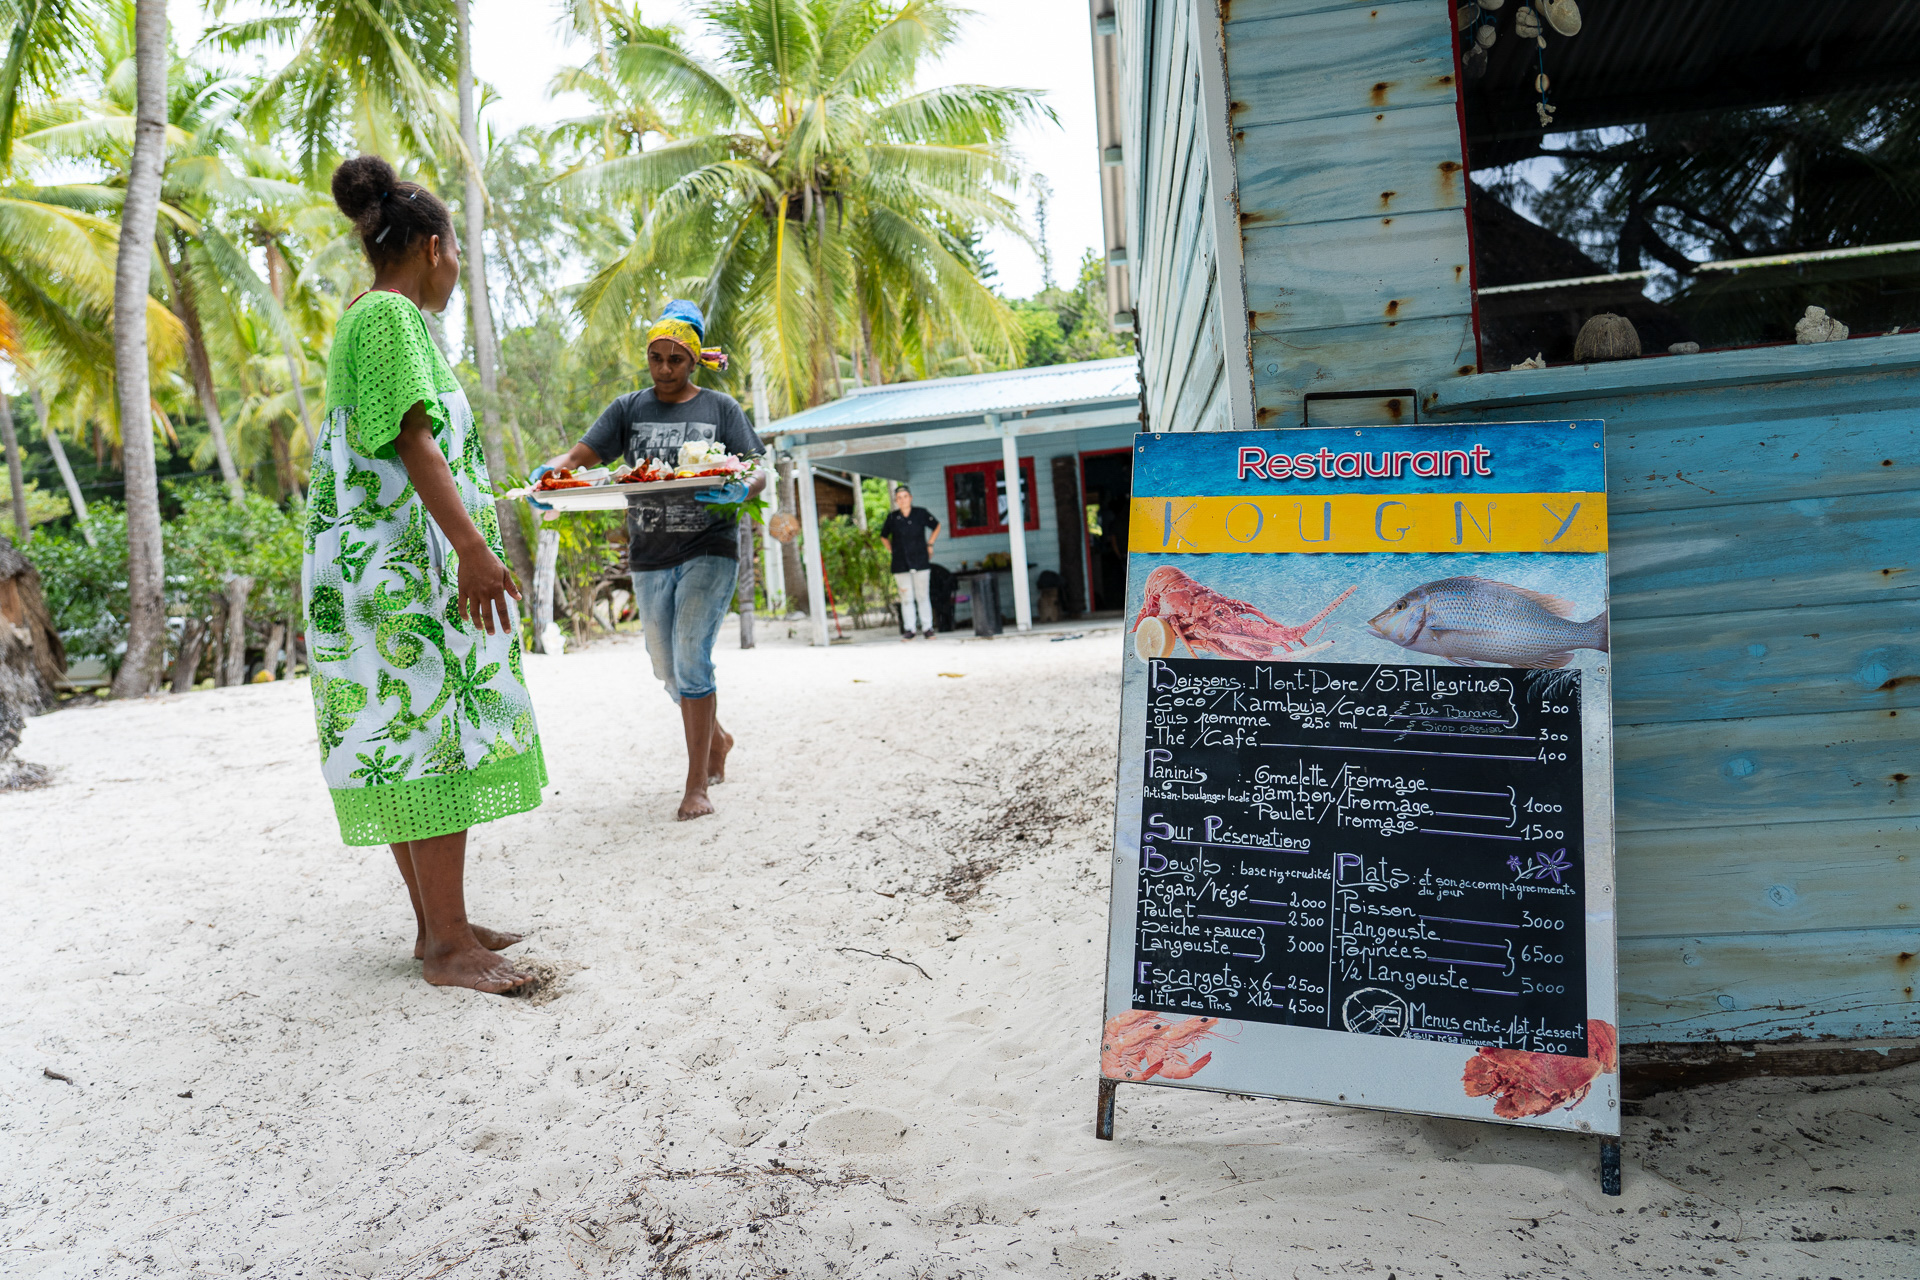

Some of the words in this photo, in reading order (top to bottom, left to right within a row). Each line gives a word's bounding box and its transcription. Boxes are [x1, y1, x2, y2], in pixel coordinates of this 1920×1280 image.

[1238, 444, 1491, 479] Restaurant
[1162, 501, 1581, 548] KOUGNY
[1541, 701, 1569, 714] 500
[1194, 712, 1271, 732] pomme
[1301, 717, 1331, 730] 250
[1340, 715, 1357, 729] ml
[1539, 728, 1568, 741] 300
[1538, 747, 1567, 764] 400
[1145, 749, 1208, 791] Paninis
[1523, 797, 1562, 812] 1000
[1143, 813, 1194, 842] Sur
[1204, 815, 1311, 849] Réservation
[1521, 824, 1564, 840] 1500
[1240, 861, 1267, 877] base
[1419, 868, 1432, 886] et
[1436, 877, 1459, 887] son
[1418, 887, 1434, 896] du
[1436, 887, 1465, 901] jour
[1522, 911, 1565, 930] 3000
[1521, 945, 1564, 963] 6500
[1368, 958, 1470, 990] Langouste
[1521, 977, 1565, 994] 5000
[1132, 988, 1146, 1002] de
[1181, 994, 1203, 1009] des
[1204, 994, 1232, 1011] Pins
[1410, 1001, 1460, 1030] Menus
